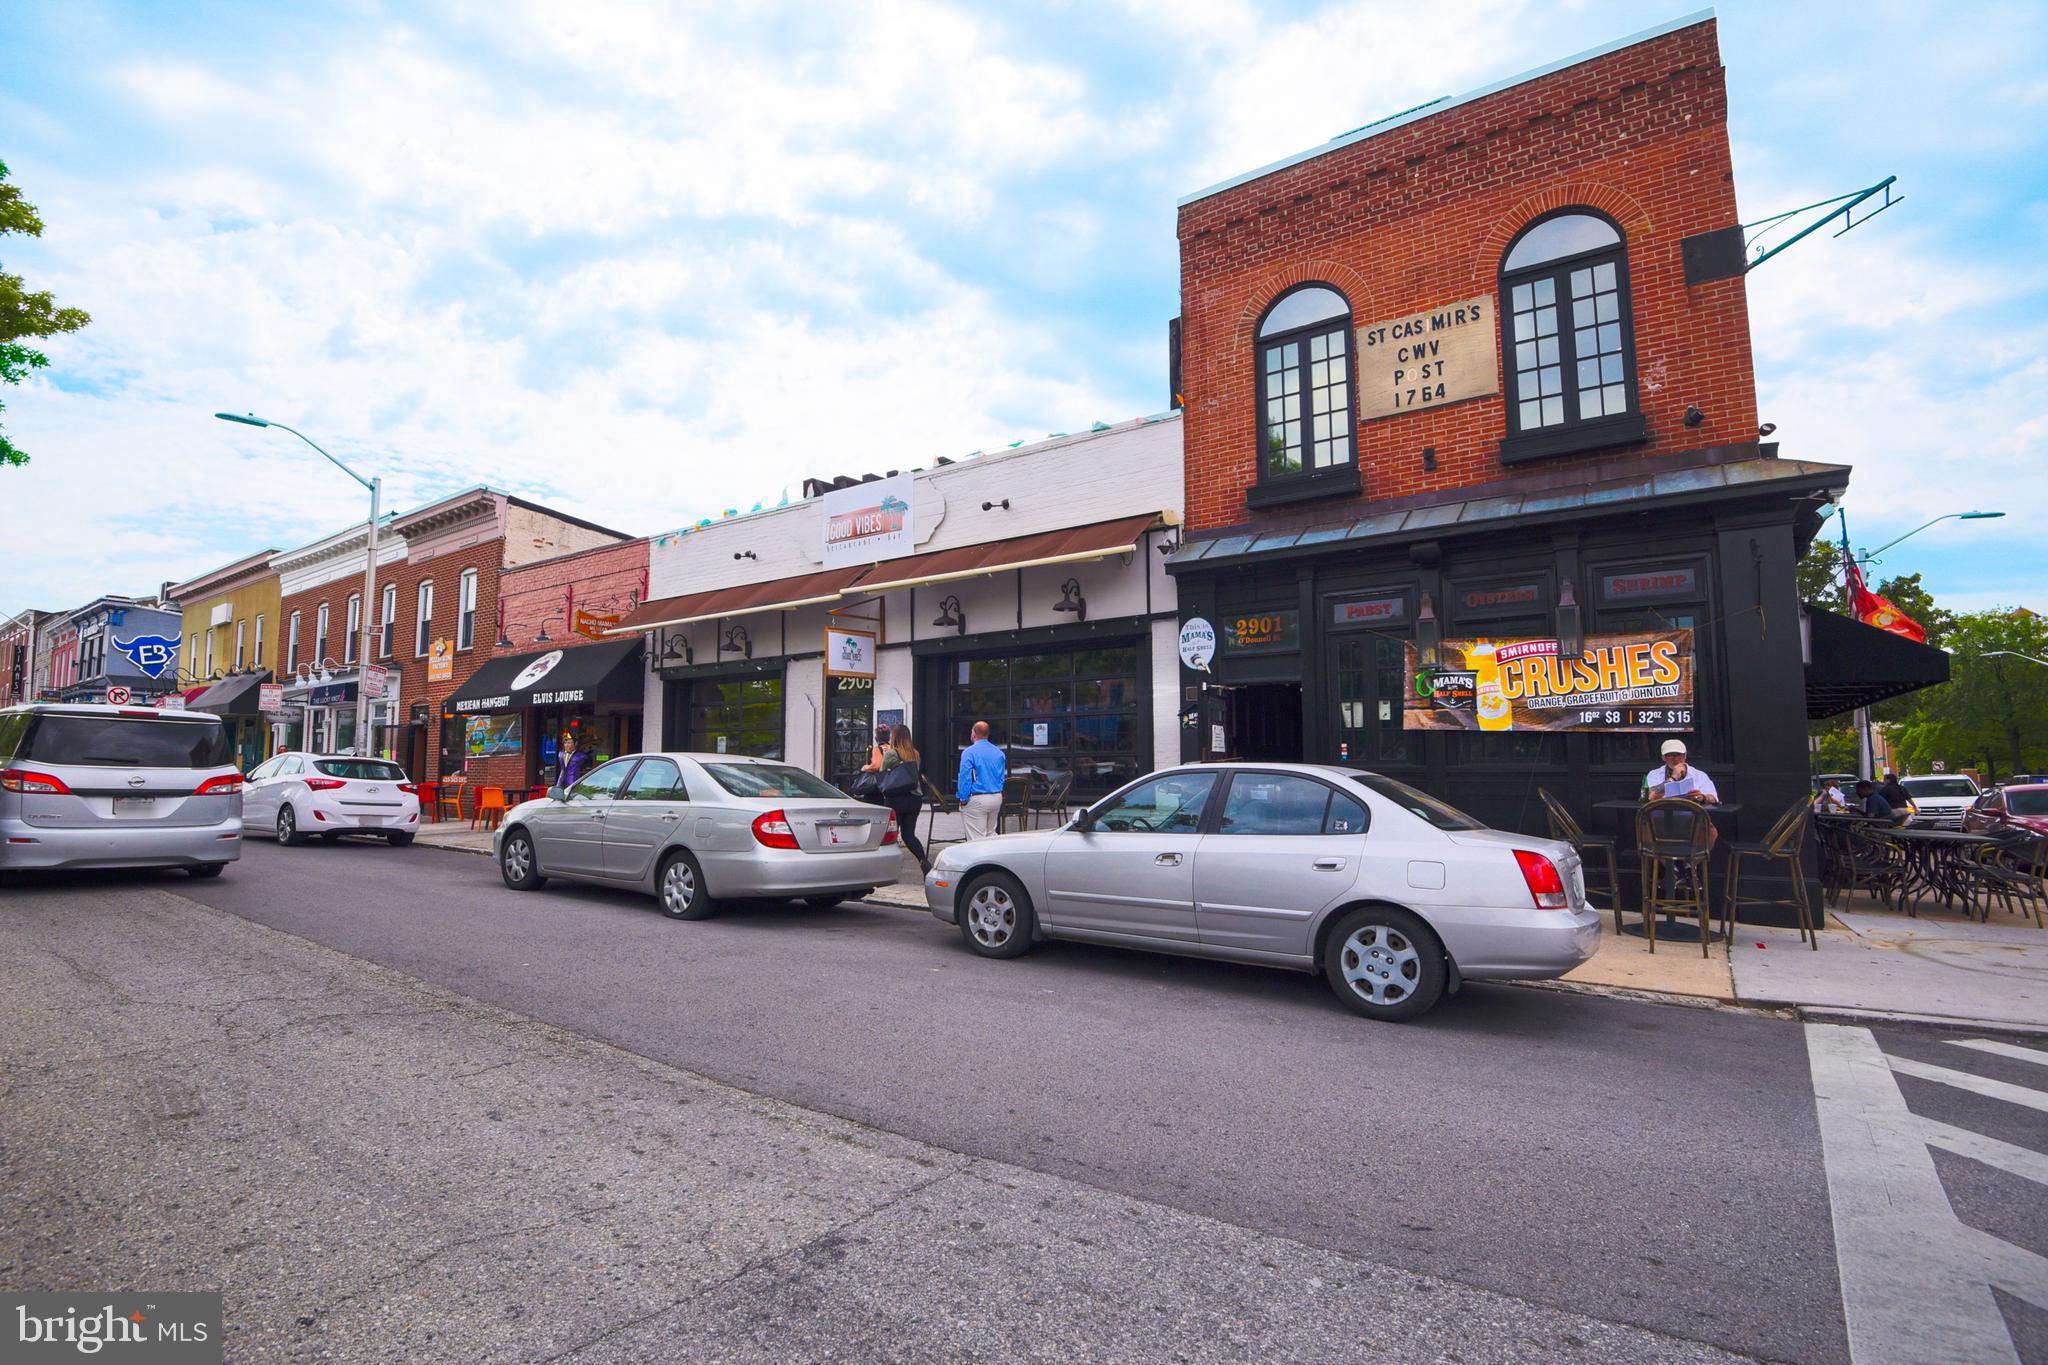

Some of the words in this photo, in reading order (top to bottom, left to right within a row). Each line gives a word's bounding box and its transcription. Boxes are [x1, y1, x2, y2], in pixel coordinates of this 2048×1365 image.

[1368, 328, 1386, 346] ST
[1392, 305, 1481, 339] CASIMIR'S
[1398, 339, 1440, 363] CWV
[1394, 360, 1445, 386] POST
[1395, 383, 1446, 408] 1764
[830, 518, 853, 541] GOOD
[855, 512, 882, 535] VIBES
[1236, 615, 1283, 636] 2901
[1181, 631, 1214, 644] MAMA'S
[1500, 642, 1558, 659] SMIRNOFF
[1498, 640, 1680, 700] CRUSHES
[1433, 675, 1474, 689] MAMA'S
[533, 692, 553, 704] ELVIS
[555, 690, 584, 702] LOUNGE
[1434, 690, 1451, 698] HALF
[1452, 690, 1473, 698] SHELL
[1528, 697, 1565, 710] ORANGE,
[1566, 690, 1620, 706] GRAPEFRUIT
[1621, 690, 1628, 700] &
[1629, 687, 1654, 700] JOHN
[1655, 684, 1680, 697] DALY
[456, 700, 481, 712] MEXICAN
[1605, 710, 1620, 724] $8
[1667, 710, 1691, 723] $15
